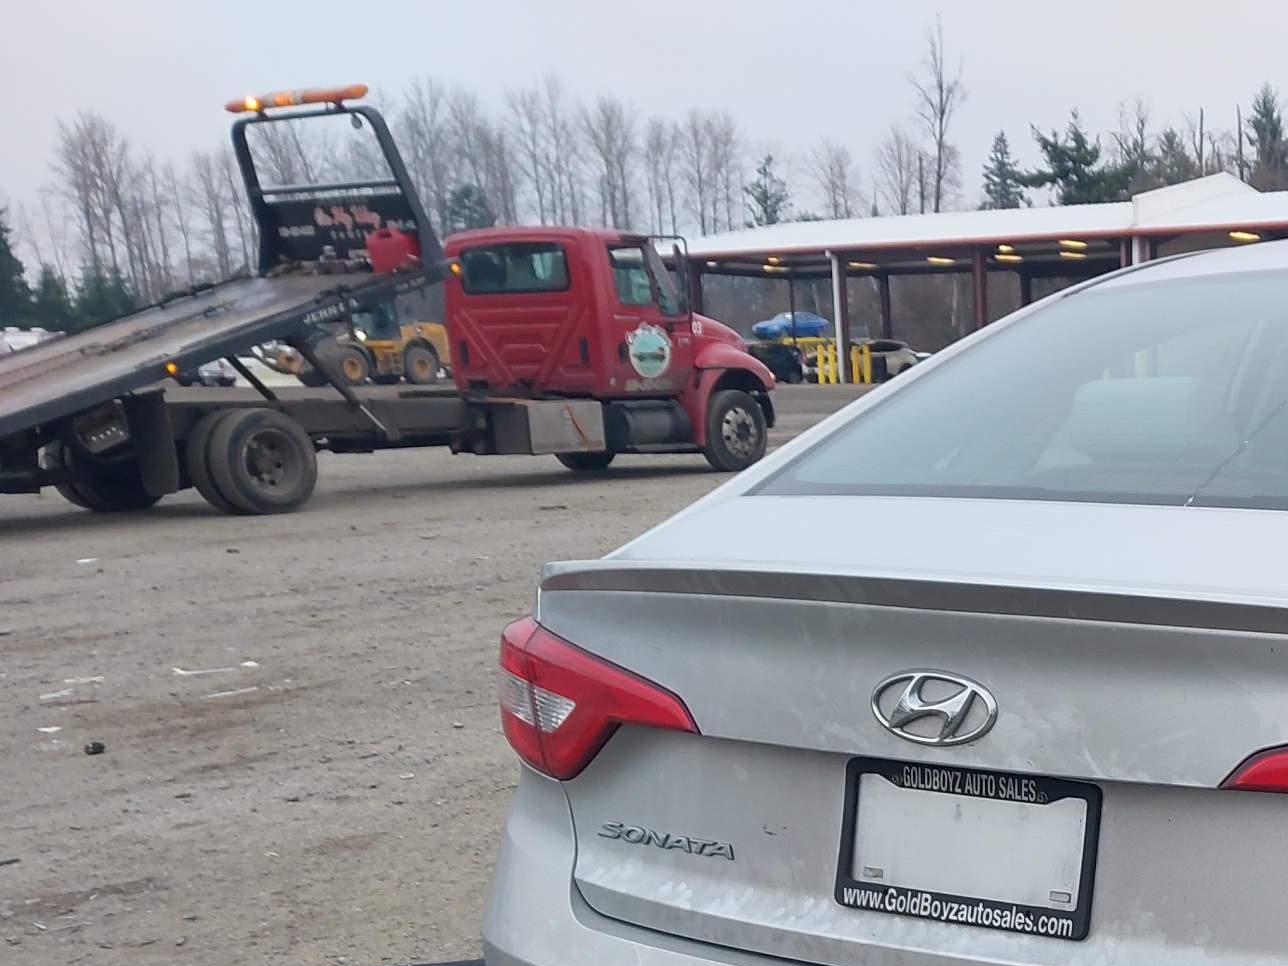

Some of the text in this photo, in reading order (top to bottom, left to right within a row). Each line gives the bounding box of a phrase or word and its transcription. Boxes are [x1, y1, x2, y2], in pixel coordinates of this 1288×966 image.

[902, 765, 1037, 802] GOLDBOYZ AUTO SALES
[597, 820, 735, 861] SONATA
[843, 886, 1074, 936] www.GoldBoyzautosales.com
